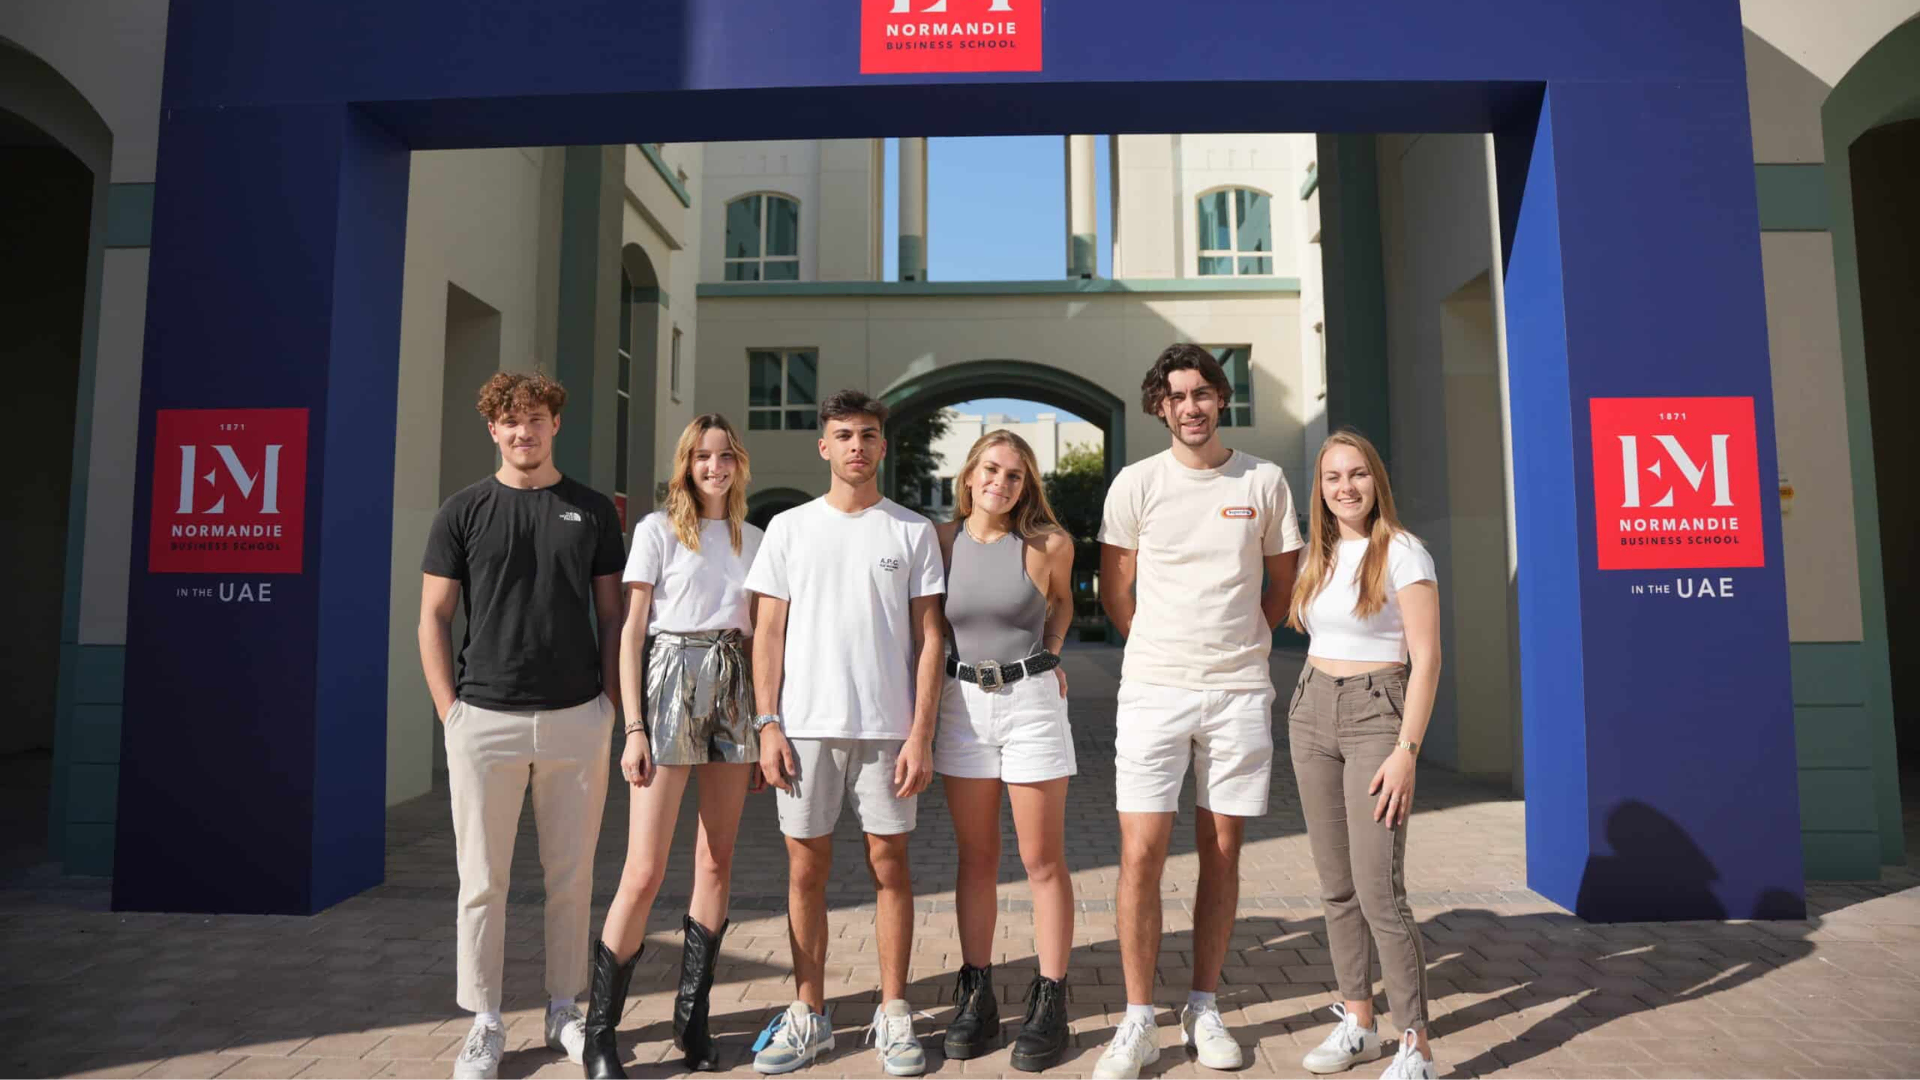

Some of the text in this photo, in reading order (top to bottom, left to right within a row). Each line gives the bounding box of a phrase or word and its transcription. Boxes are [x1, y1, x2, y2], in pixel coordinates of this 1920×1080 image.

[887, 22, 1016, 37] NORMANDIE
[887, 40, 1015, 50] BUSINESS SCHOOL
[1659, 412, 1686, 420] 1871
[1617, 434, 1734, 508] EM
[175, 444, 284, 514] EM
[172, 525, 282, 537] NORMANDIE
[1619, 517, 1739, 532] NORMANDIE
[171, 542, 281, 551] BUSINESS SCHOOL
[1620, 535, 1739, 546] BUSINESS SCHOOL
[176, 582, 272, 602] IN THE UAE
[1631, 577, 1734, 599] IN THE UAE
